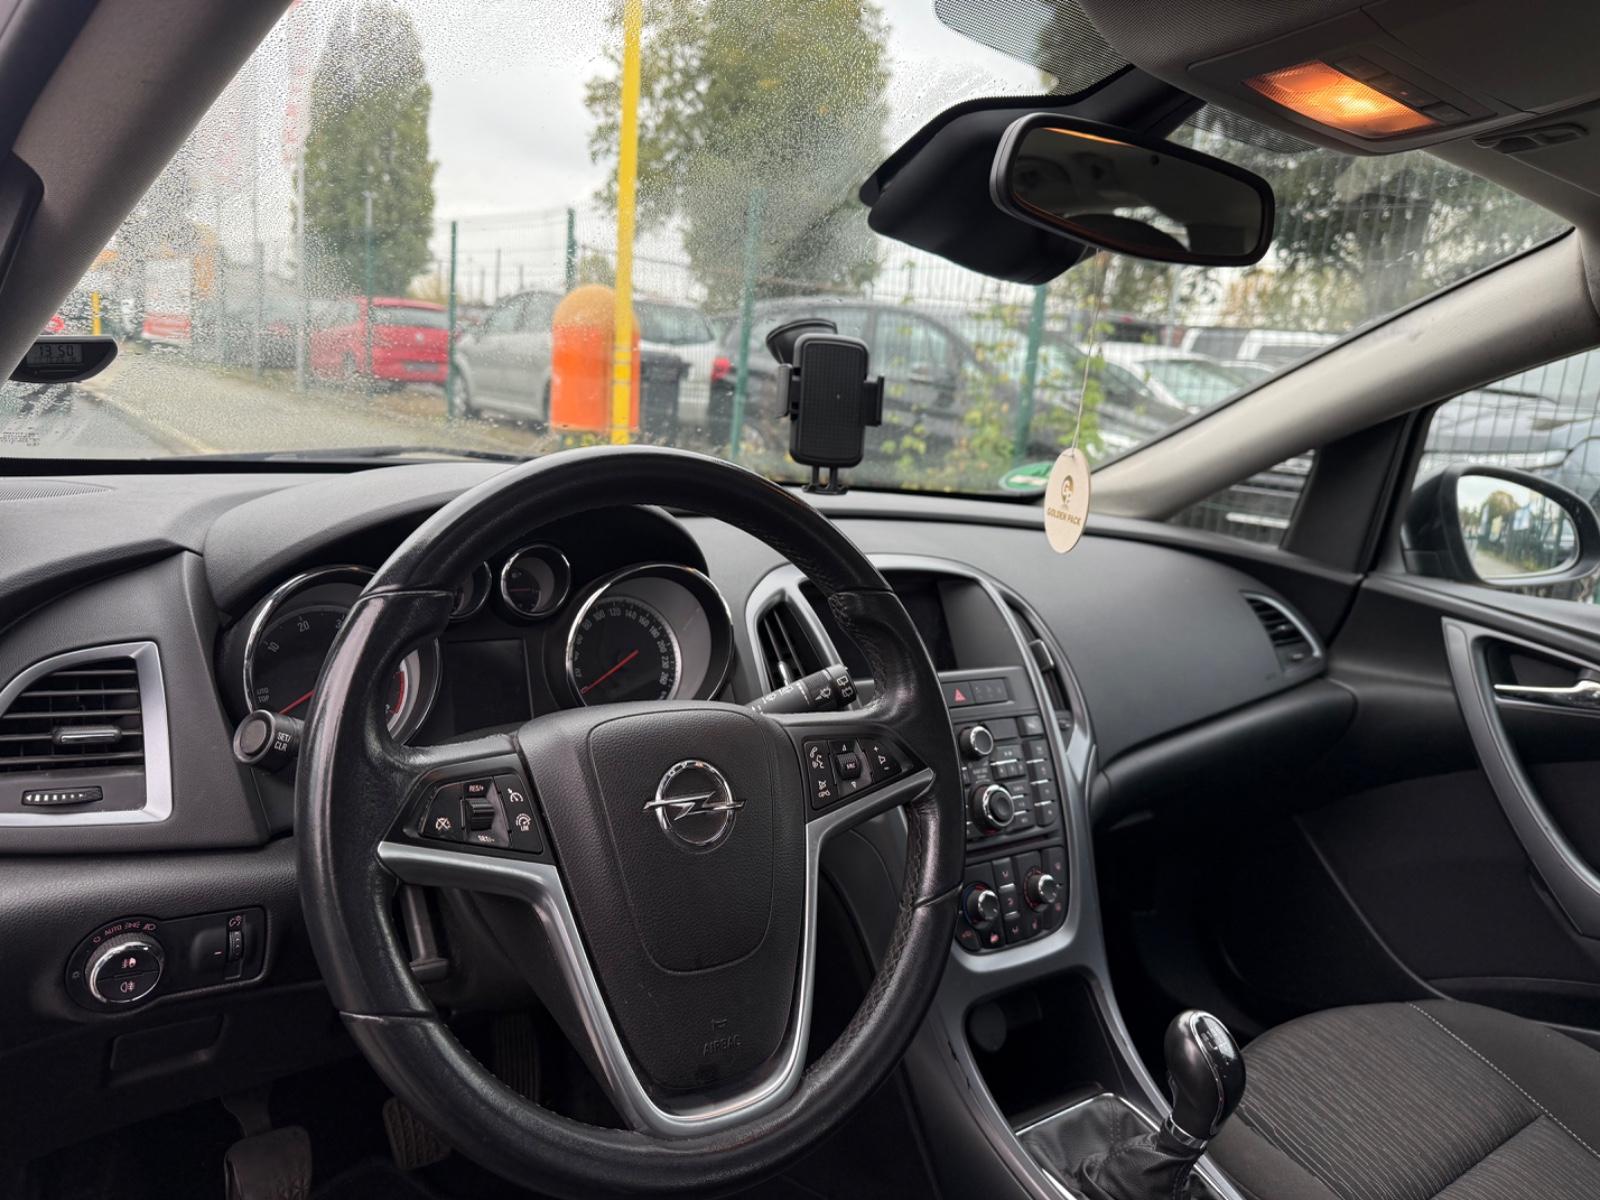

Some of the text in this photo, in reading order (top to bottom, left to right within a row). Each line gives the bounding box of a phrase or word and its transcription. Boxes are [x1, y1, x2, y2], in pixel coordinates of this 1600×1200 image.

[1047, 507, 1067, 521] GOLDEN
[297, 619, 310, 633] 20
[267, 640, 280, 654] 10
[274, 741, 288, 752] CLR
[104, 924, 122, 935] AUTO
